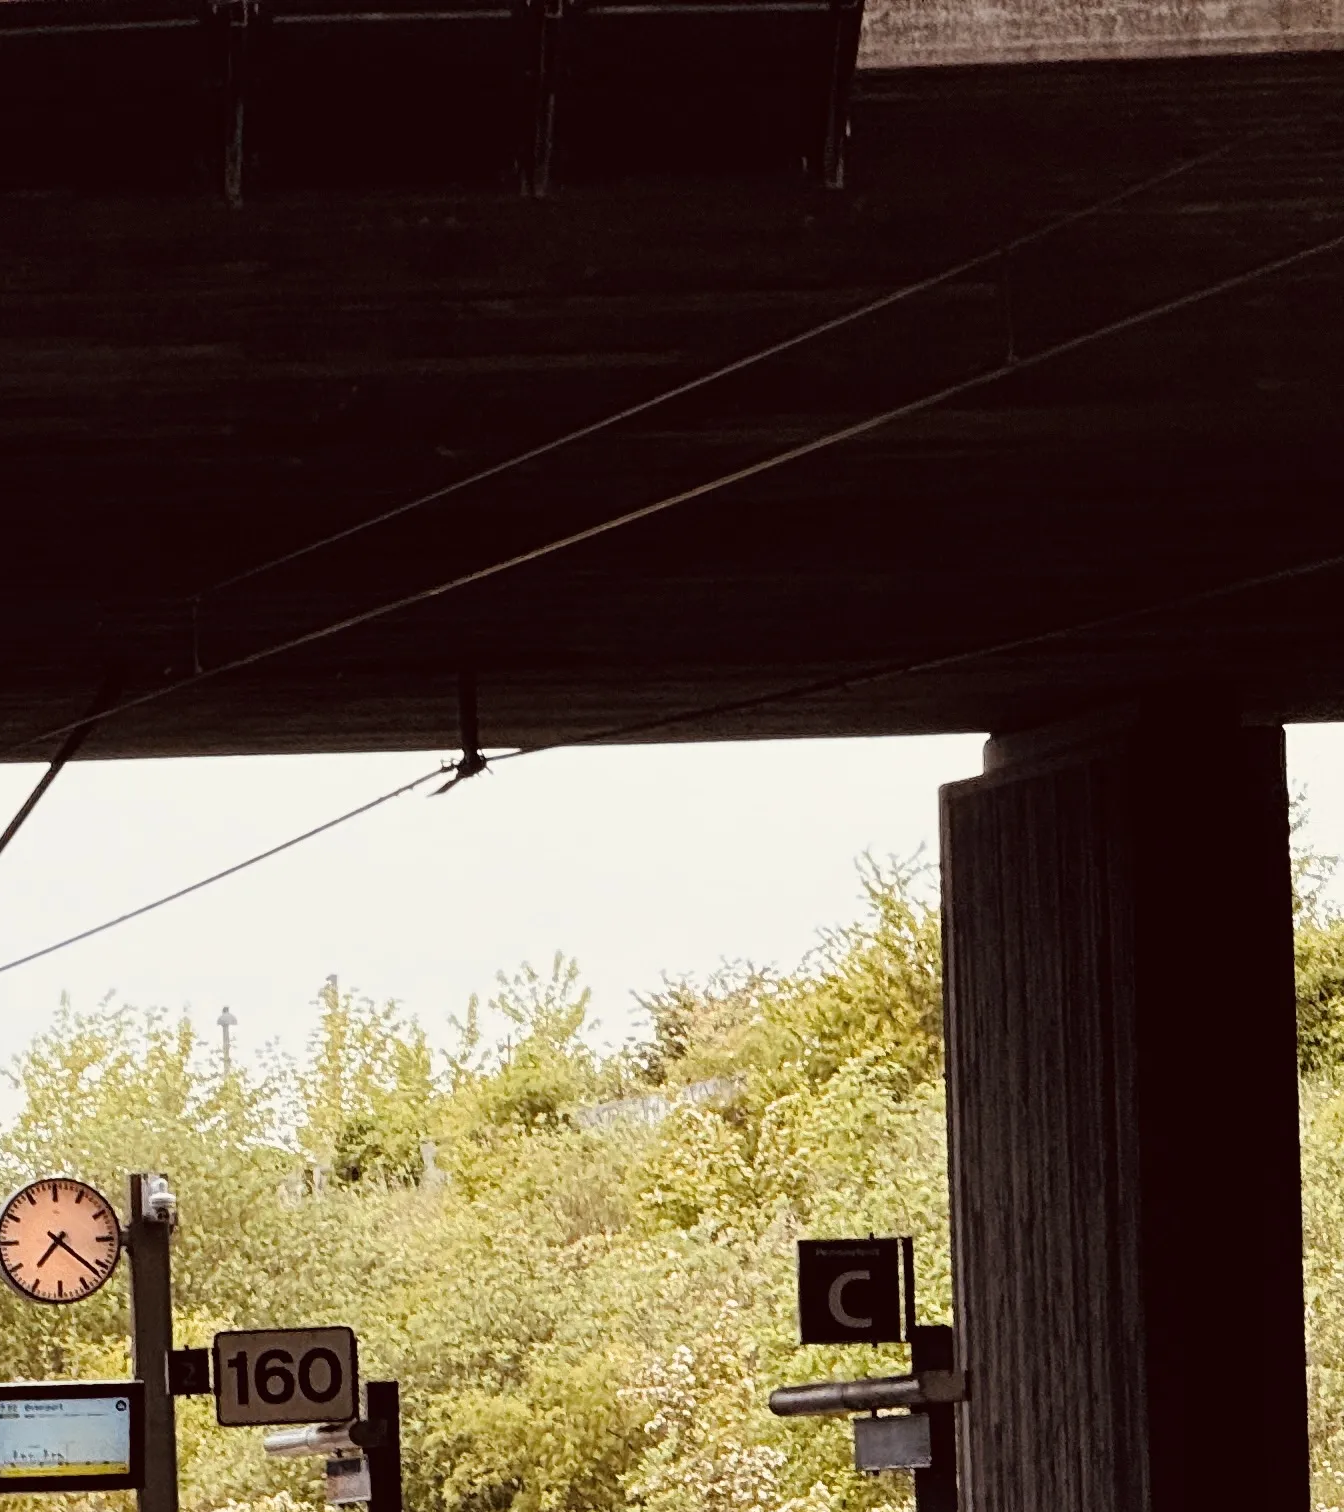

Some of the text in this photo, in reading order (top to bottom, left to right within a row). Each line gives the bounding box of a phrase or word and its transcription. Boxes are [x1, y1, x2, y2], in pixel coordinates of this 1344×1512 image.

[828, 1269, 873, 1329] C
[180, 1361, 198, 1387] 2
[227, 1347, 343, 1405] 160
